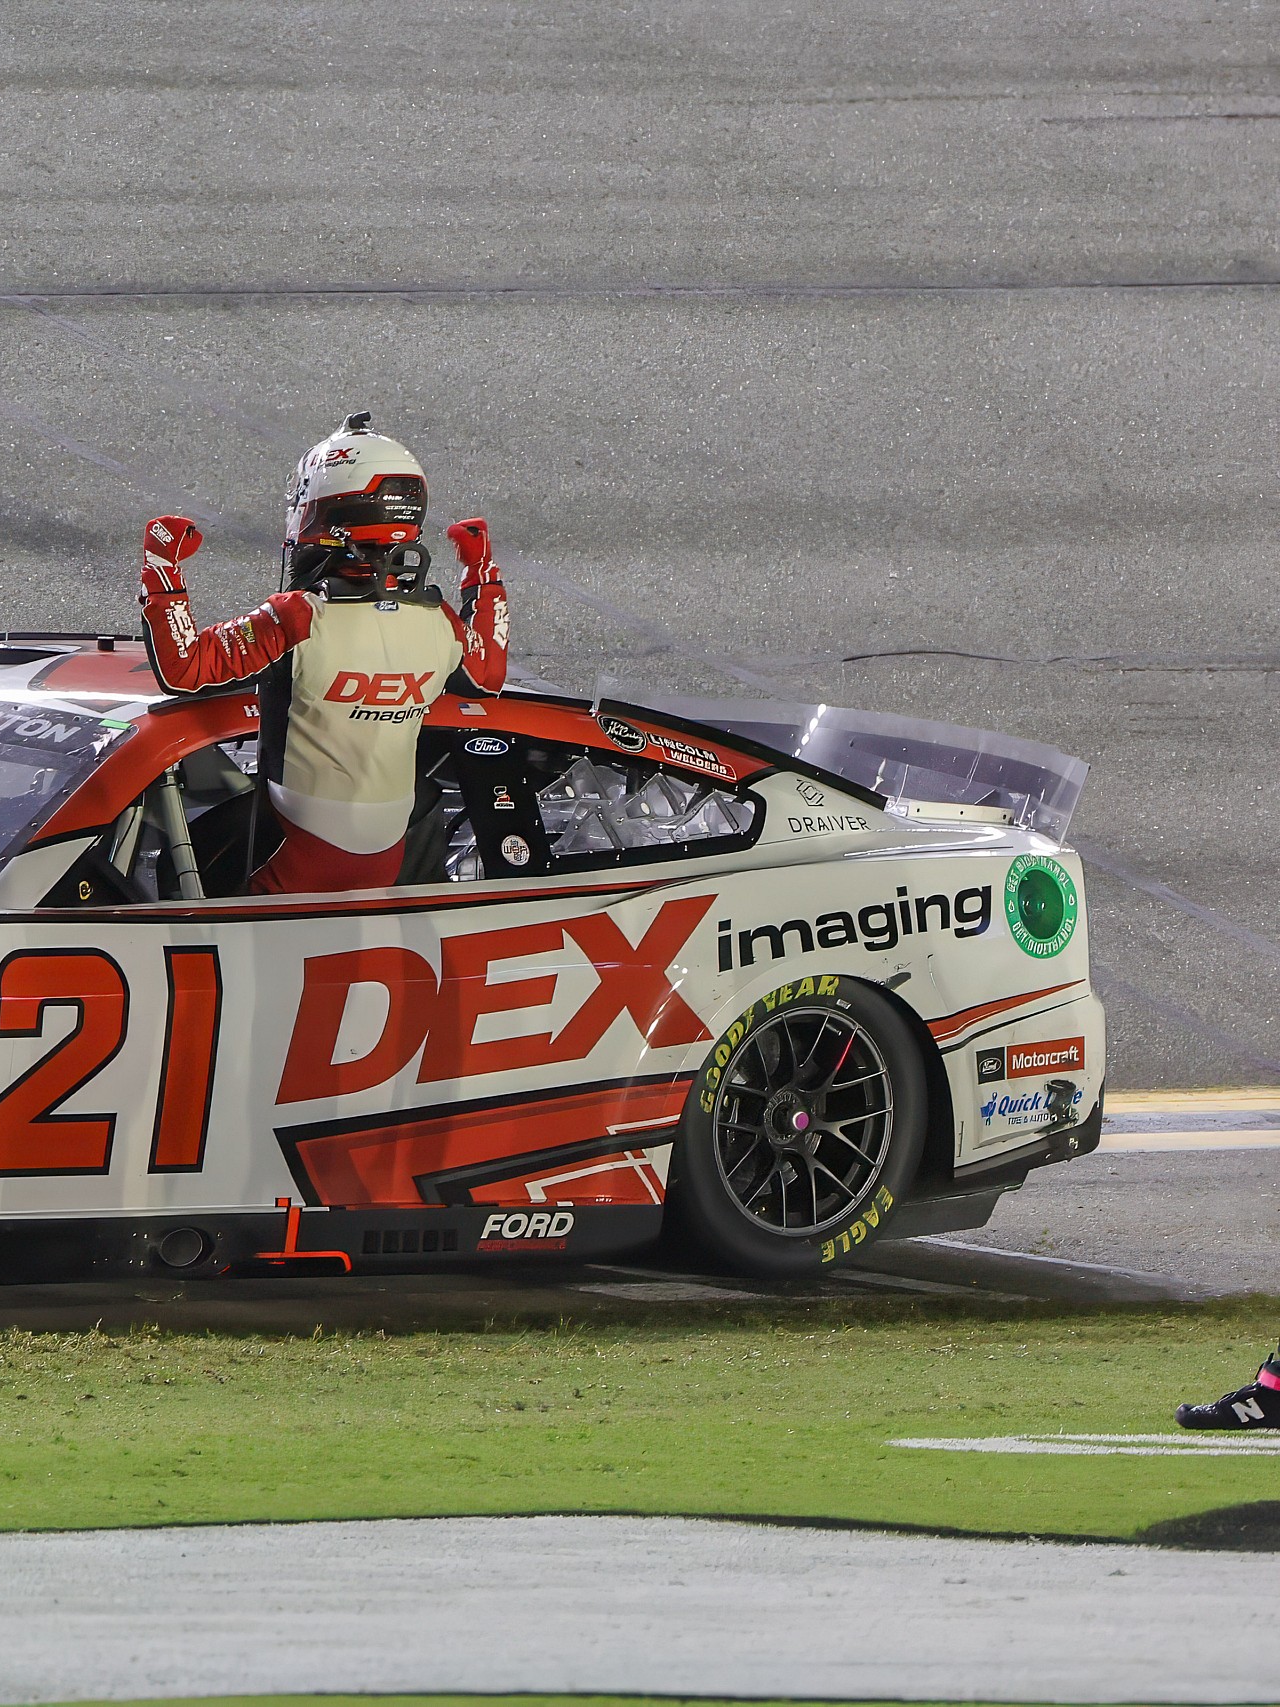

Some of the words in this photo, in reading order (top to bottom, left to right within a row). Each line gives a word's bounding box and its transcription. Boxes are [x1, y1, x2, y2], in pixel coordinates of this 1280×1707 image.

[309, 446, 354, 469] EX
[151, 523, 172, 543] OMP
[323, 670, 435, 706] DEX
[348, 705, 427, 724] imagin
[472, 738, 503, 753] Ford
[649, 733, 718, 763] LINCOLN
[787, 815, 871, 833] DRAIVER
[718, 885, 992, 973] imaging
[275, 894, 719, 1106] DEX
[1012, 1046, 1080, 1070] Motorcraft
[998, 1091, 1042, 1117] Quick
[1043, 1089, 1083, 1109] Le
[480, 1212, 575, 1240] FORD
[821, 1184, 894, 1264] EAGLE
